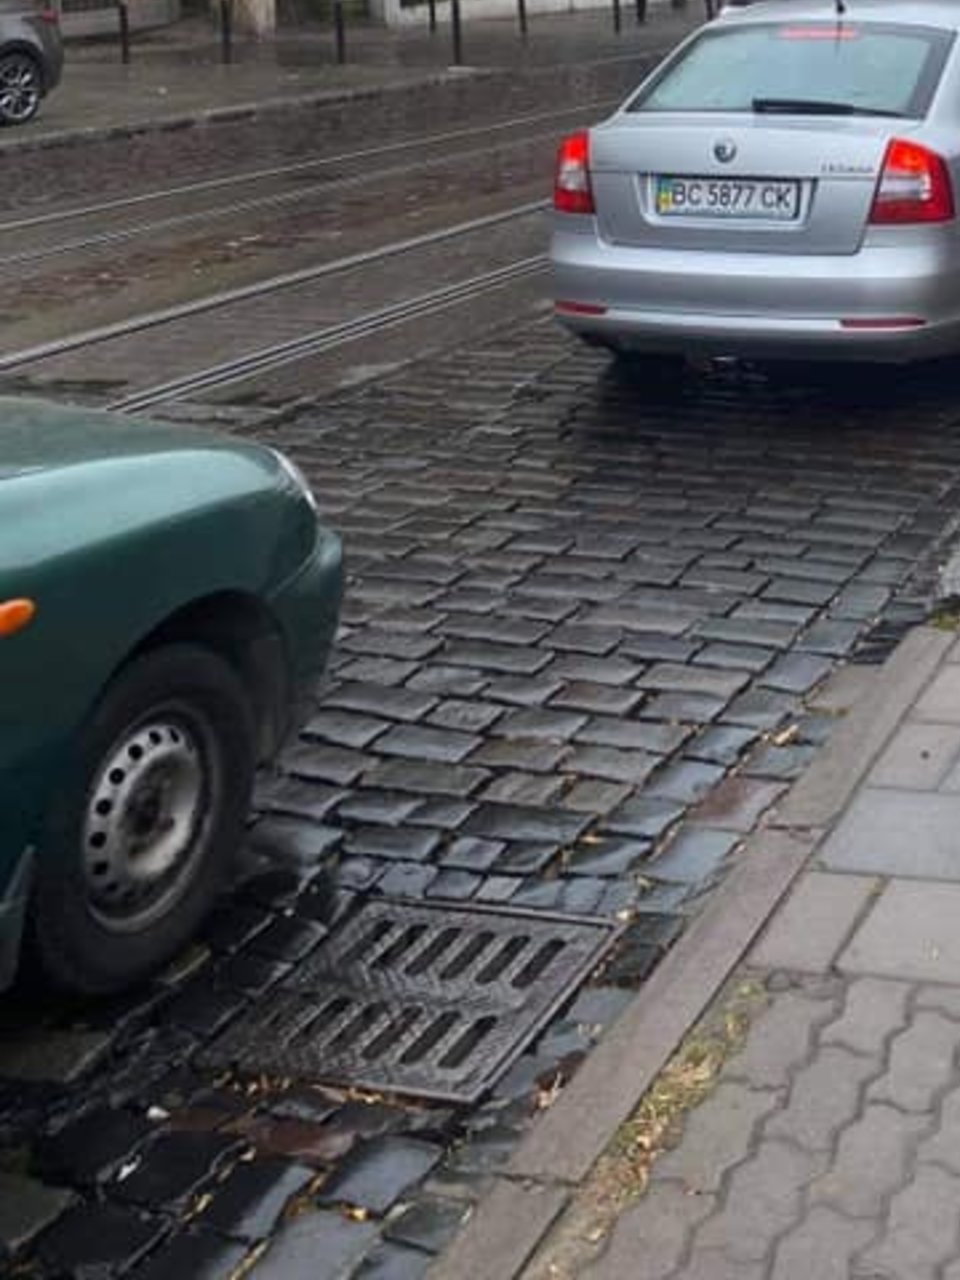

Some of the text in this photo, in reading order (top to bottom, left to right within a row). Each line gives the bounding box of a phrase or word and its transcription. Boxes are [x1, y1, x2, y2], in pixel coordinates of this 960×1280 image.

[672, 182, 791, 209] BC 5877 CK
